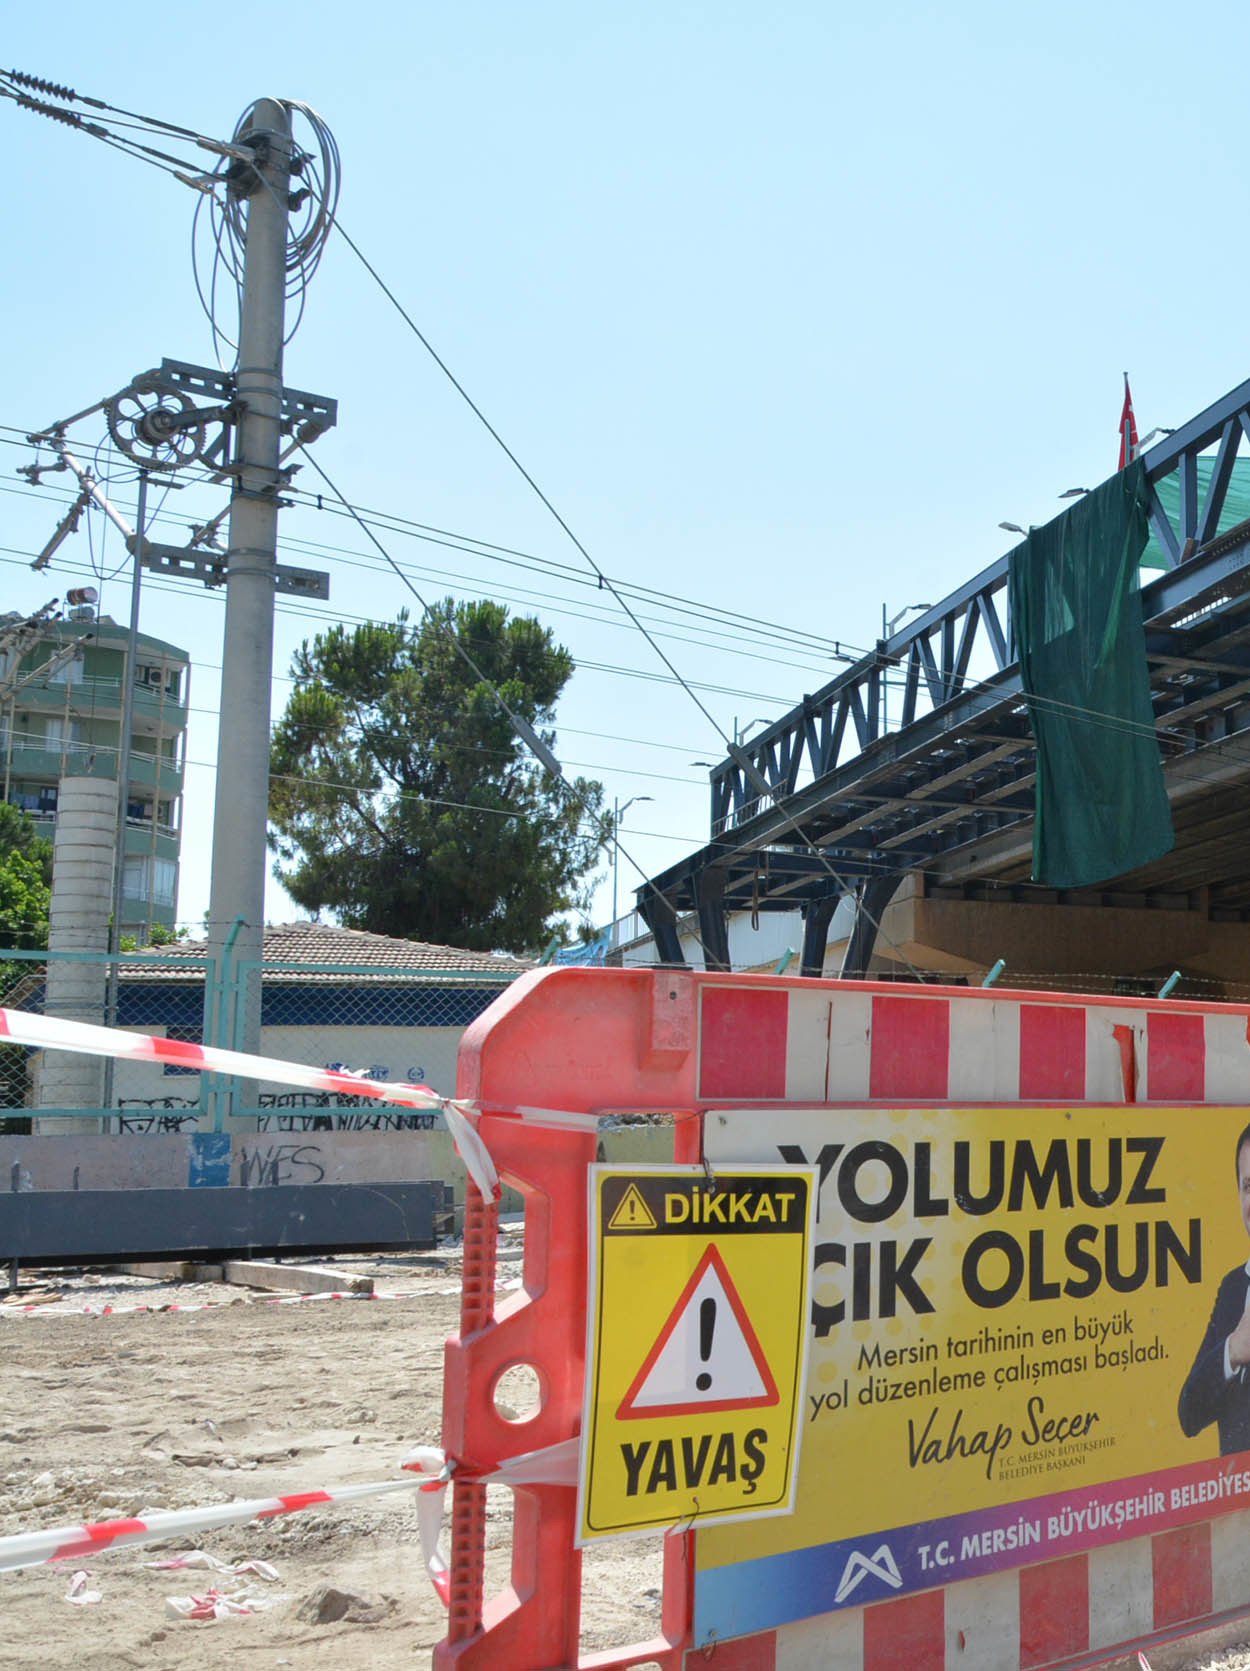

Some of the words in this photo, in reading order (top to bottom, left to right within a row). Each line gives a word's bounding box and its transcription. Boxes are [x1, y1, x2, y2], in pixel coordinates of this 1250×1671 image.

[665, 1186, 796, 1223] DİKKAT
[777, 1137, 1166, 1223] YOLUMUZ
[811, 1237, 937, 1338] ÇIK
[962, 1218, 1202, 1308] OLSUN
[810, 1379, 848, 1422] yol
[858, 1367, 986, 1405] düzenleme
[994, 1355, 1088, 1391] çalışması
[1095, 1336, 1170, 1371] başladı.
[857, 1337, 939, 1371] Mersin
[946, 1325, 1034, 1358] tarihinin
[1041, 1327, 1067, 1345] en
[1074, 1310, 1134, 1345] büyük
[620, 1428, 768, 1495] YAVAŞ
[908, 1407, 1012, 1480] Vahap
[1021, 1396, 1099, 1444] Seçer
[918, 1541, 955, 1570] T.C.
[960, 1517, 1040, 1560] MERSİN
[1047, 1487, 1166, 1540] BÜYÜKŞEHİR
